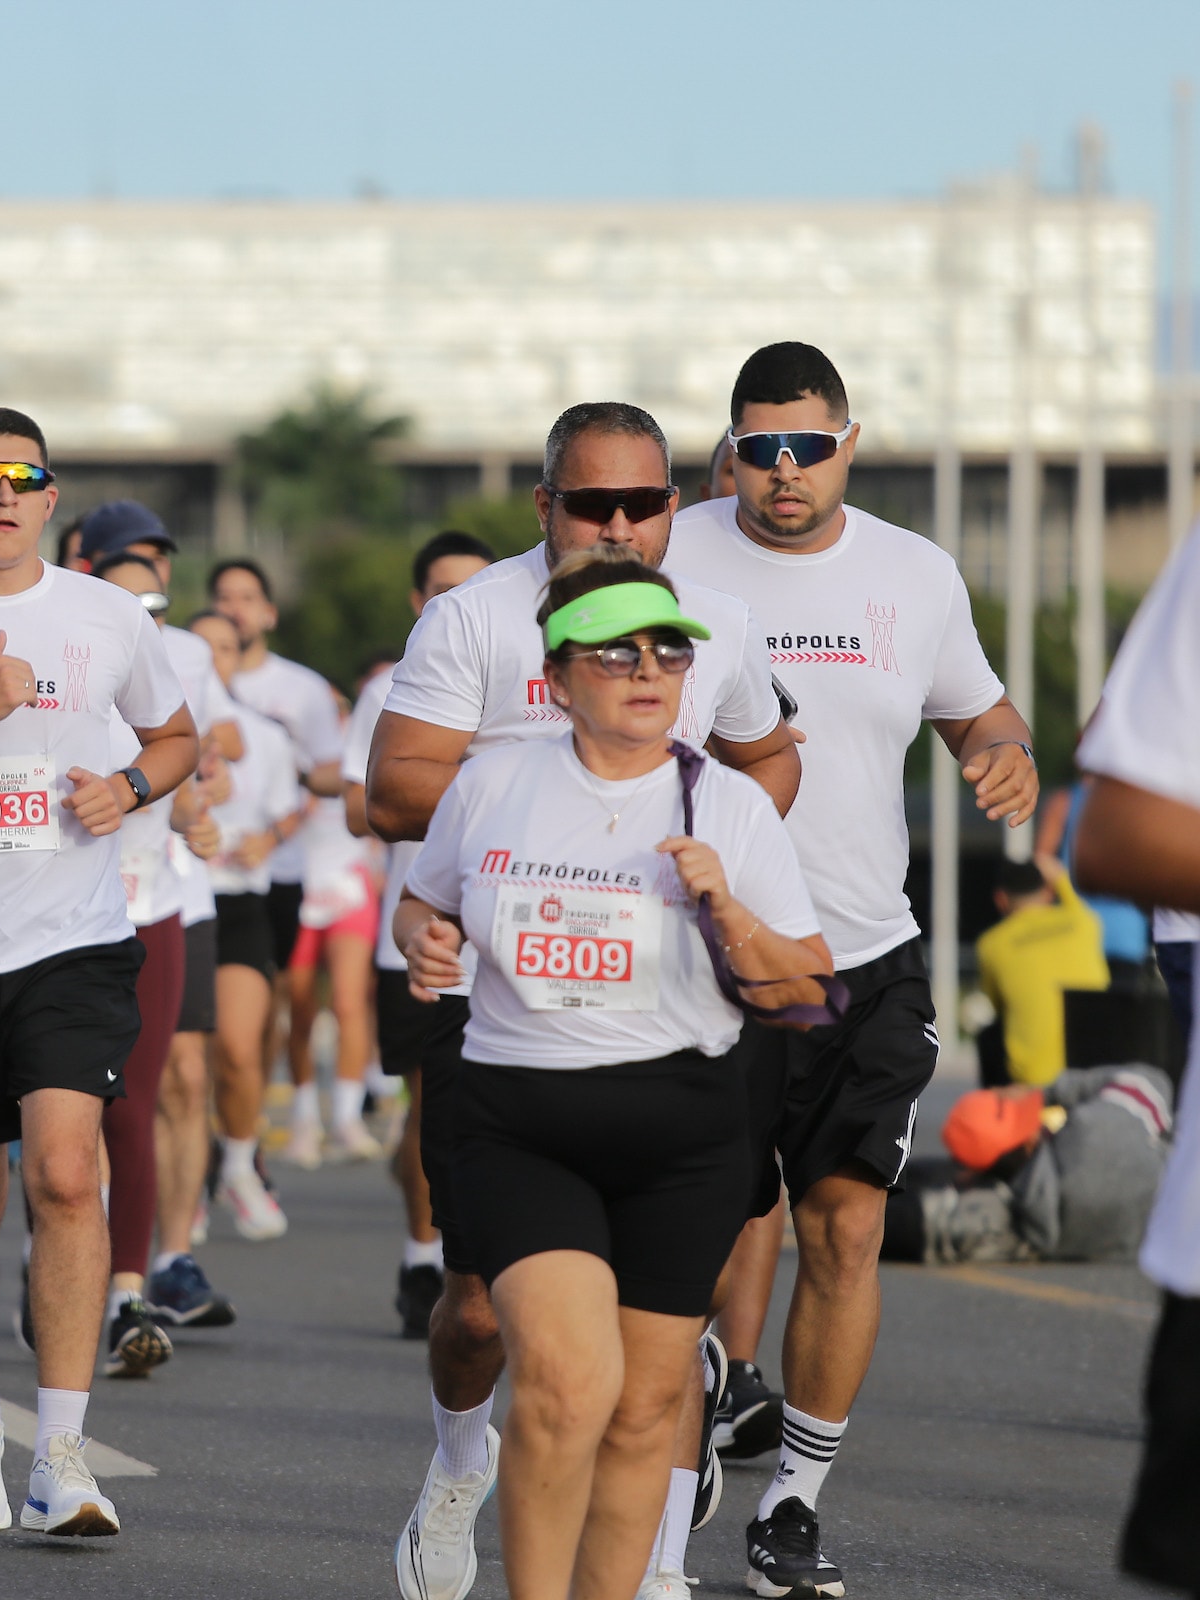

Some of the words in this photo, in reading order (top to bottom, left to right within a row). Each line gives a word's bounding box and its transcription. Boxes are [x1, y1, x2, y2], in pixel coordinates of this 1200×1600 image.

[766, 632, 861, 650] RÓPOLES
[33, 767, 46, 777] 5K
[480, 850, 641, 886] METRÓPOLES
[618, 909, 633, 920] 5K
[519, 934, 628, 979] 5809
